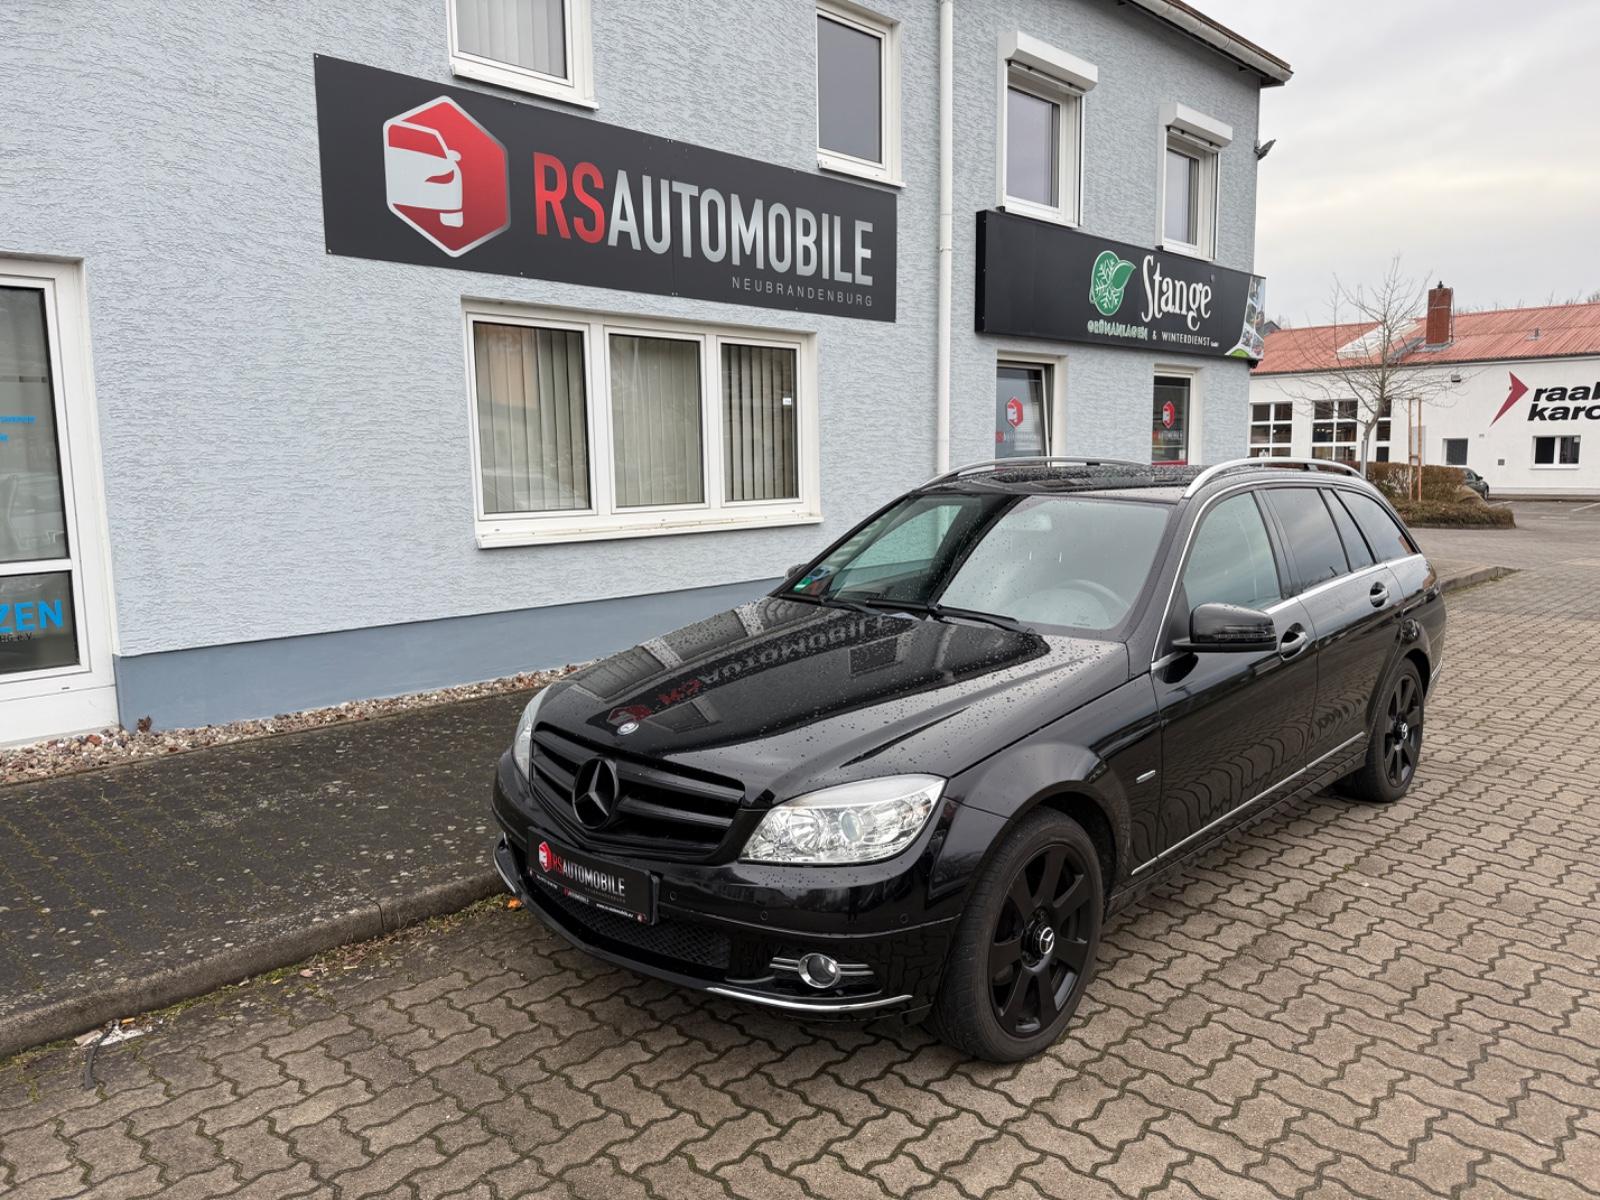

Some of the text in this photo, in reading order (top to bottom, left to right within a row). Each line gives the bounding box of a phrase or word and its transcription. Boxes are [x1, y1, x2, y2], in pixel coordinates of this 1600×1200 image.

[533, 151, 874, 286] RSAUTOMOBILE
[732, 276, 874, 308] NEUBRANDENBURG
[1141, 255, 1212, 331] Stange
[1152, 330, 1157, 340] &
[1161, 331, 1211, 347] WINTERDIENST
